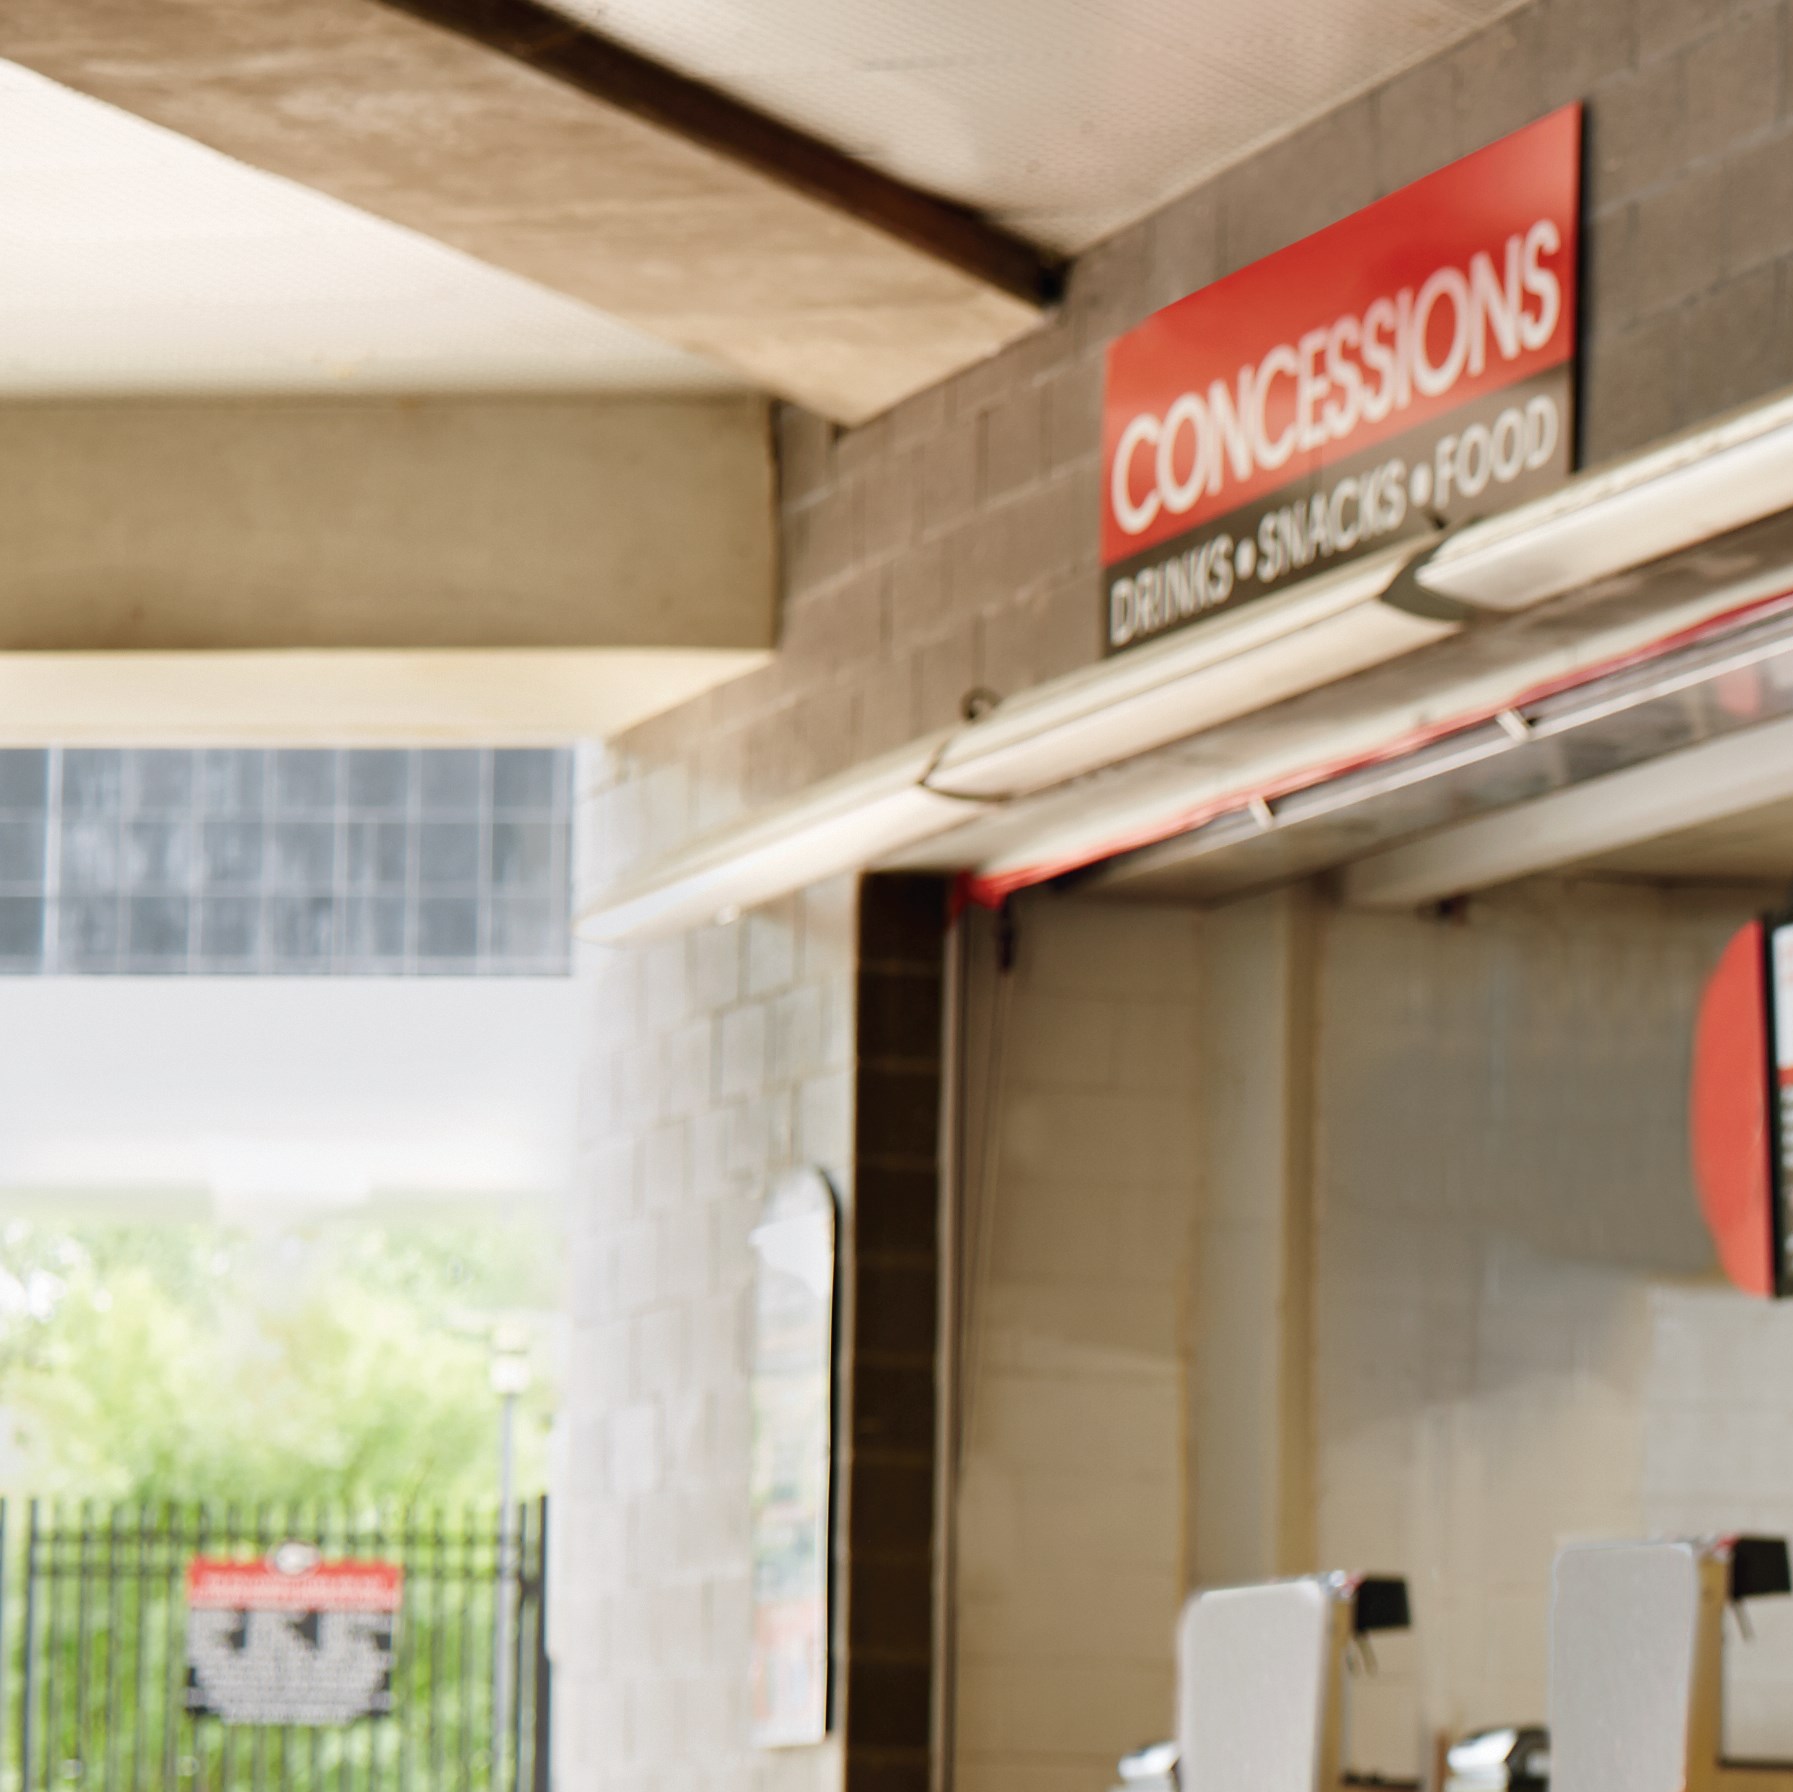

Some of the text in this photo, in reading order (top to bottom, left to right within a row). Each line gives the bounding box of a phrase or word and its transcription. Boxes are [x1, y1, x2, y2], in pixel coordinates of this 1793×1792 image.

[1111, 218, 1561, 536] CONCESSIONS
[1110, 394, 1559, 647] DRINKS SNACKS FOOD
